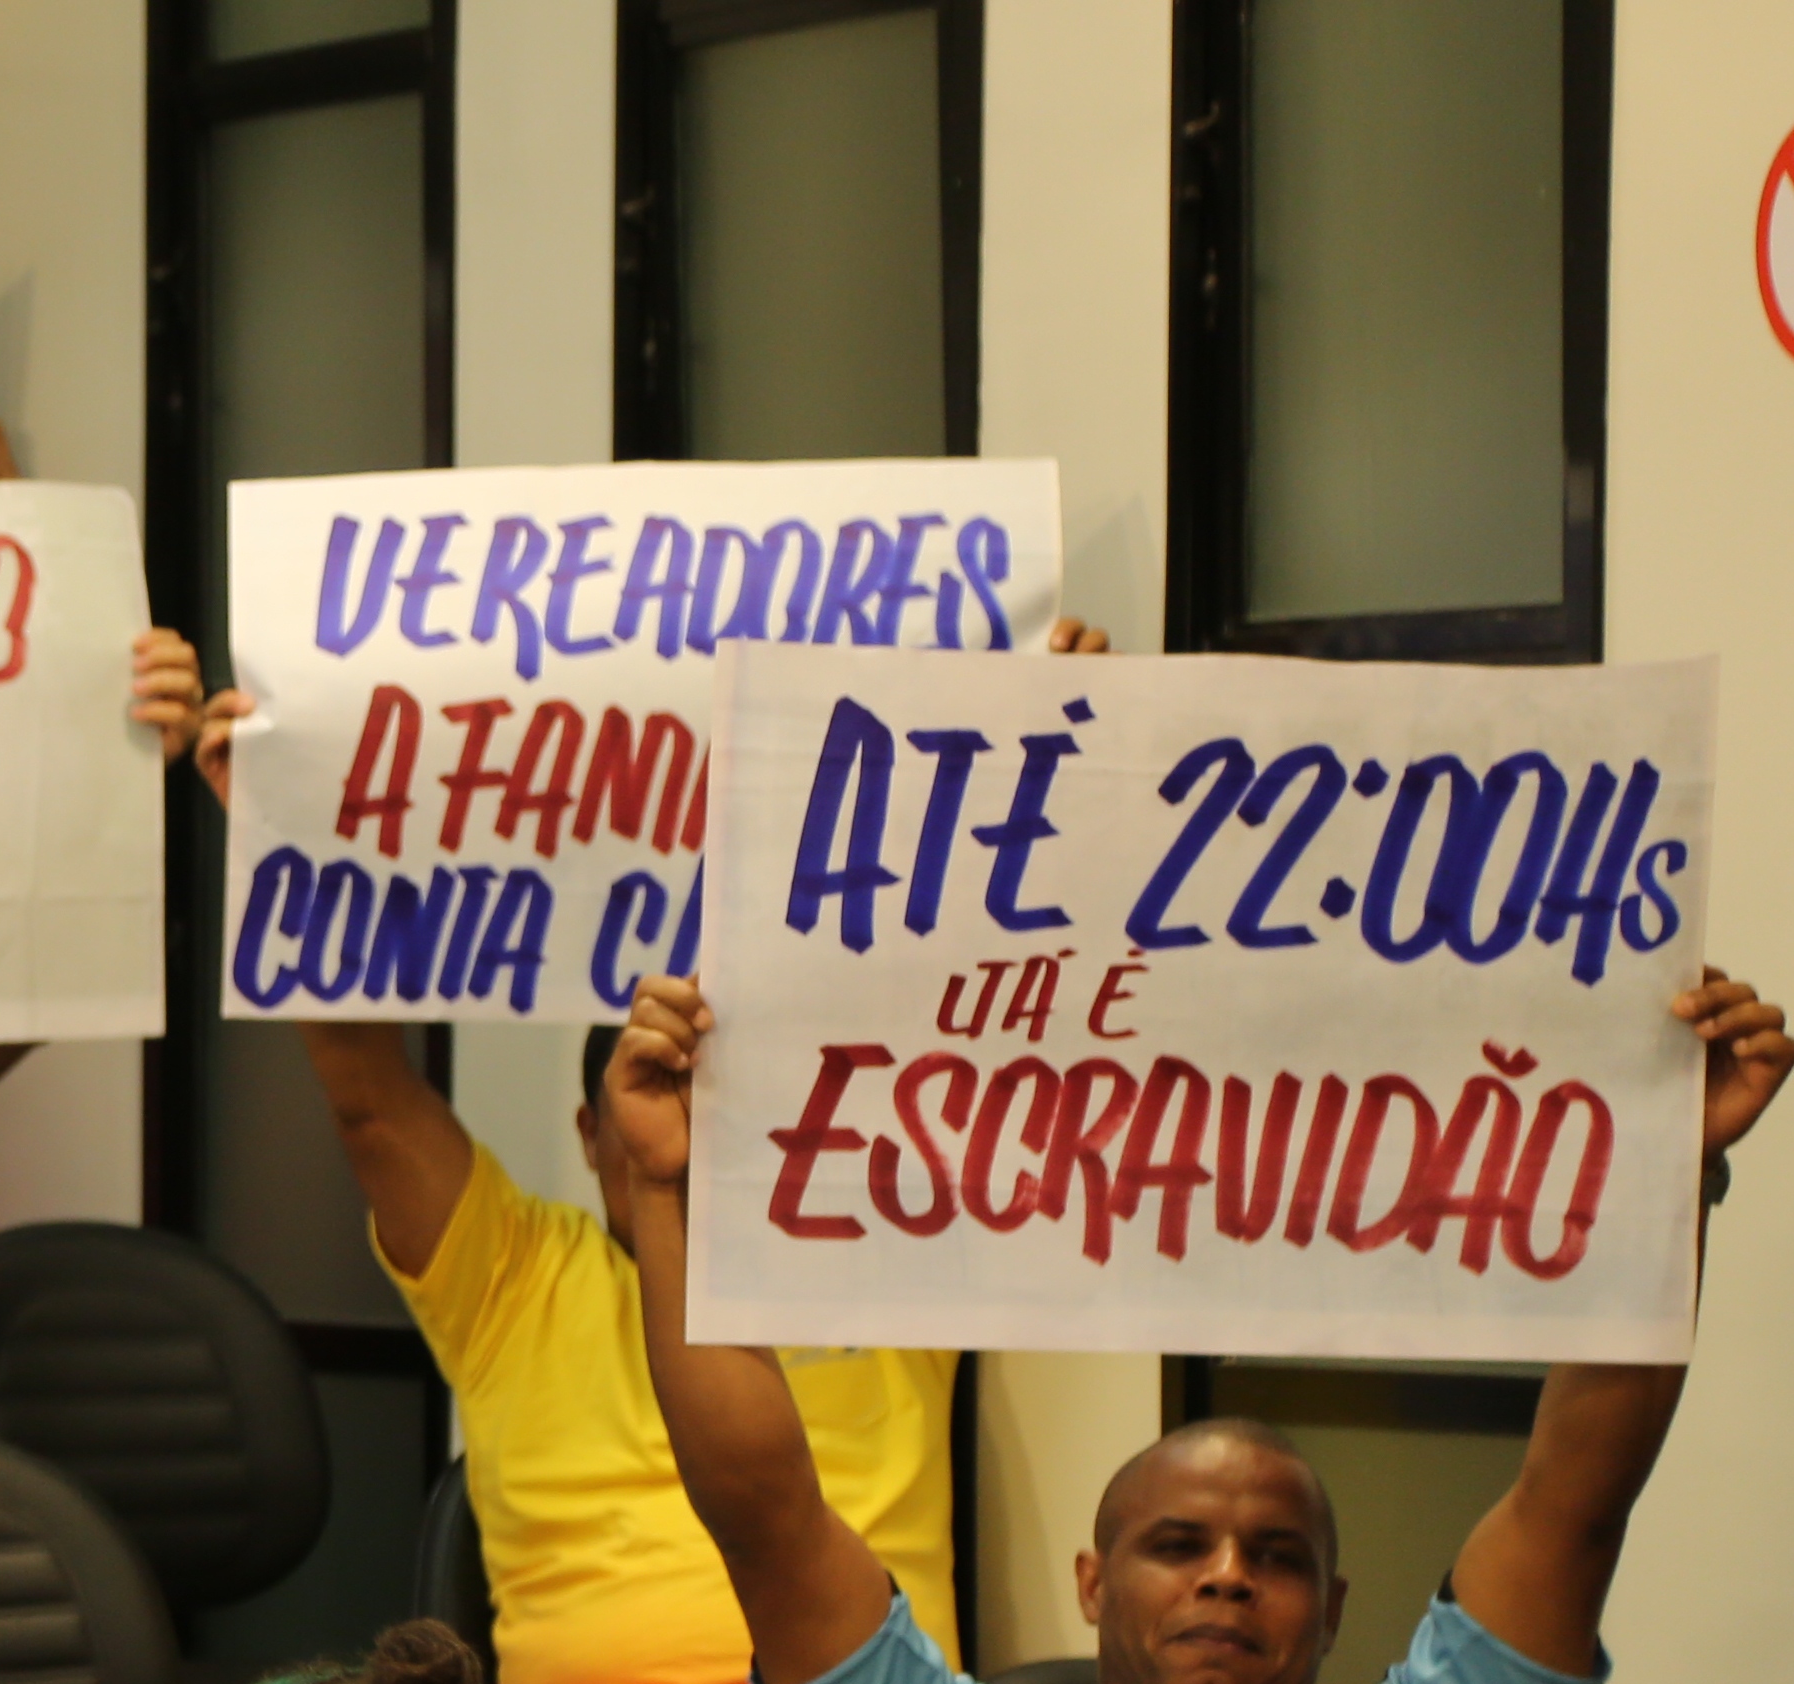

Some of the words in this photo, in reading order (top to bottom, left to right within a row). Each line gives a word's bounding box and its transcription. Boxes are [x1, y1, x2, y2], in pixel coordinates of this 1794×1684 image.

[313, 512, 1012, 682] VEREADORES
[334, 683, 422, 860] A
[785, 695, 1096, 954] ATÉ
[233, 846, 553, 1014] CONTA
[1087, 947, 1150, 1040] É
[767, 1037, 1616, 1281] ESCRAVIDÃO
